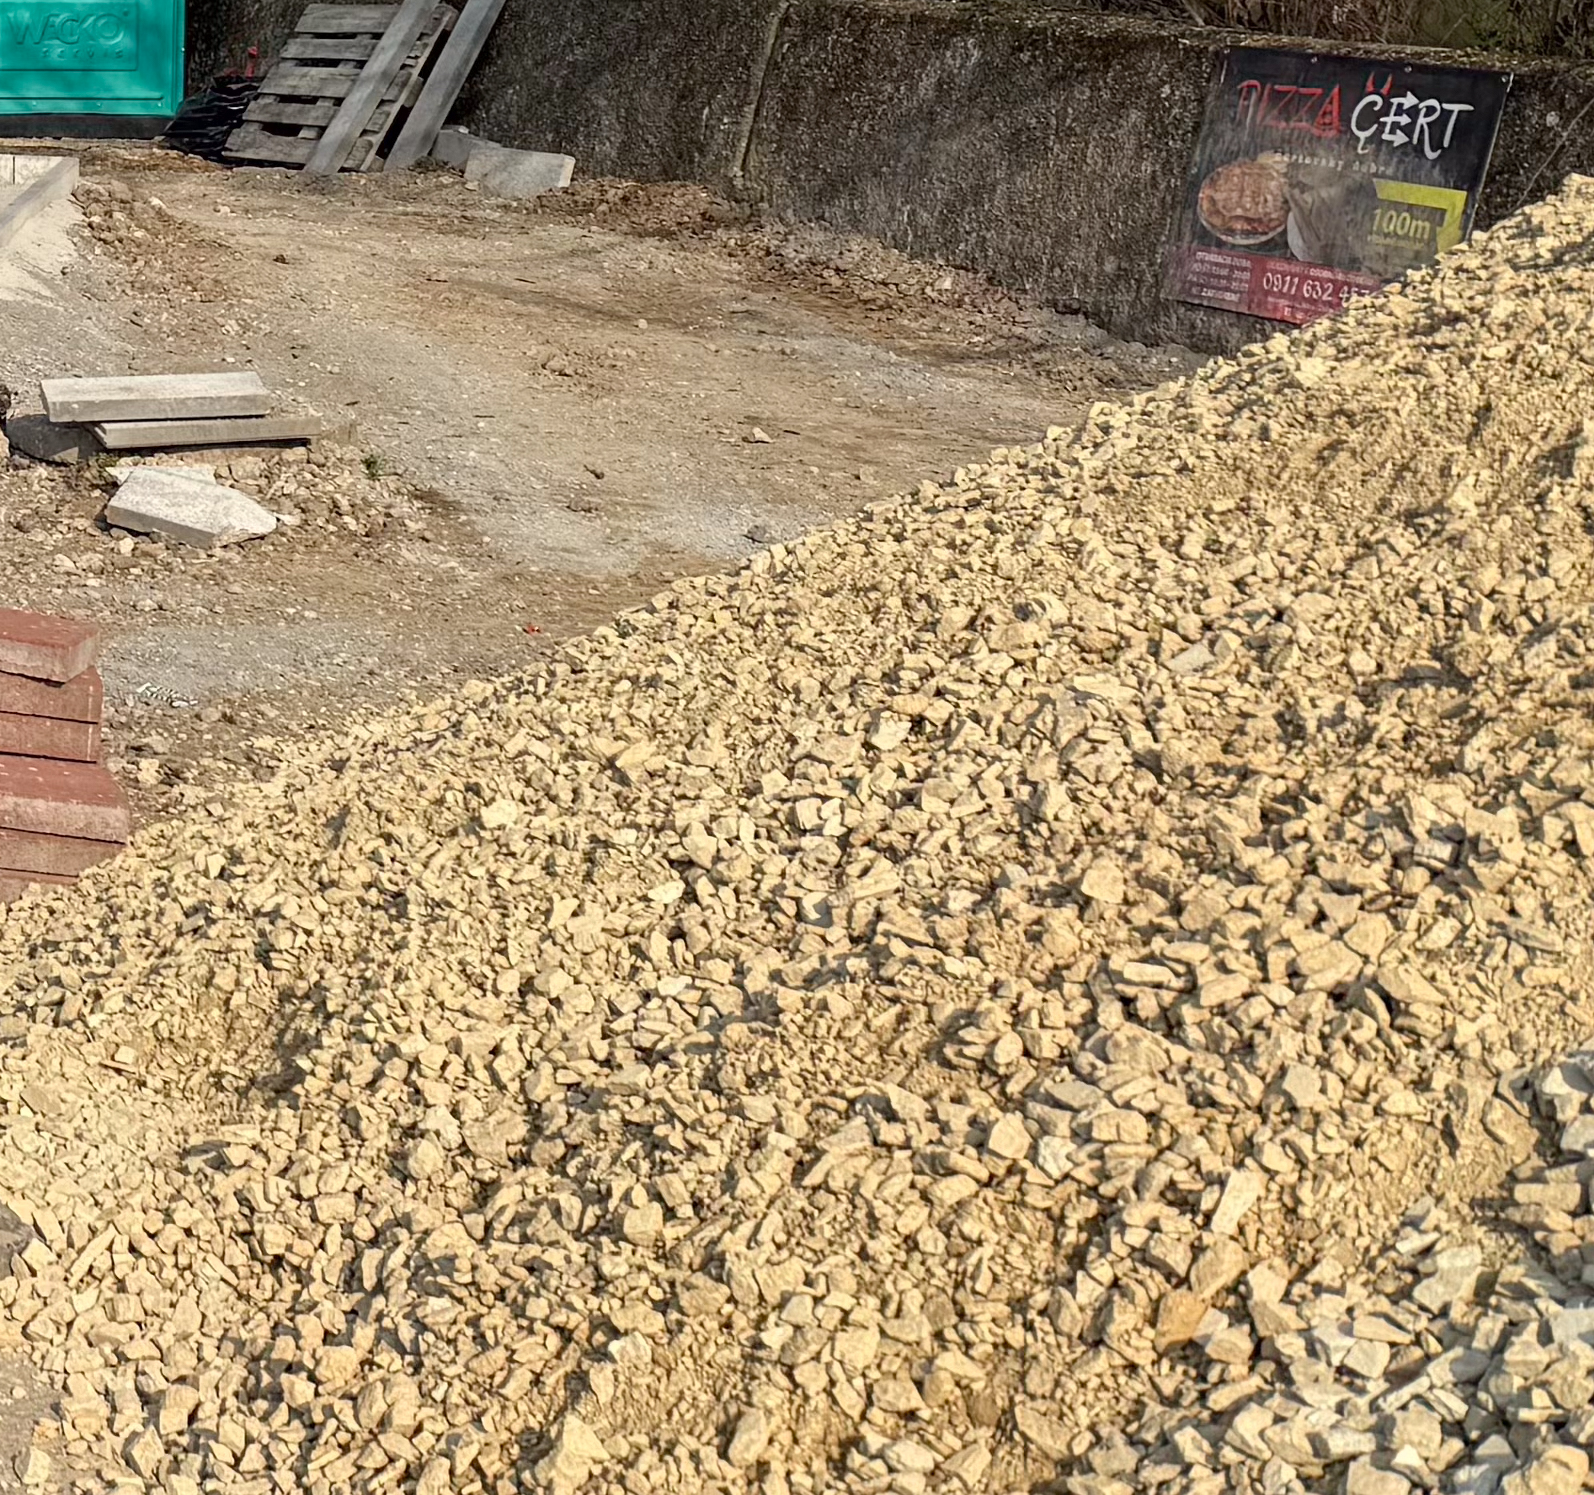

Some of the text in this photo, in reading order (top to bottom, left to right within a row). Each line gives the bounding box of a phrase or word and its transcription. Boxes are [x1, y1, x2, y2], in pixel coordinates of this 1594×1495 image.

[1237, 79, 1341, 139] PIZZA
[1373, 208, 1430, 240] 100m
[1263, 272, 1299, 295] 0911
[1303, 280, 1333, 301] 632
